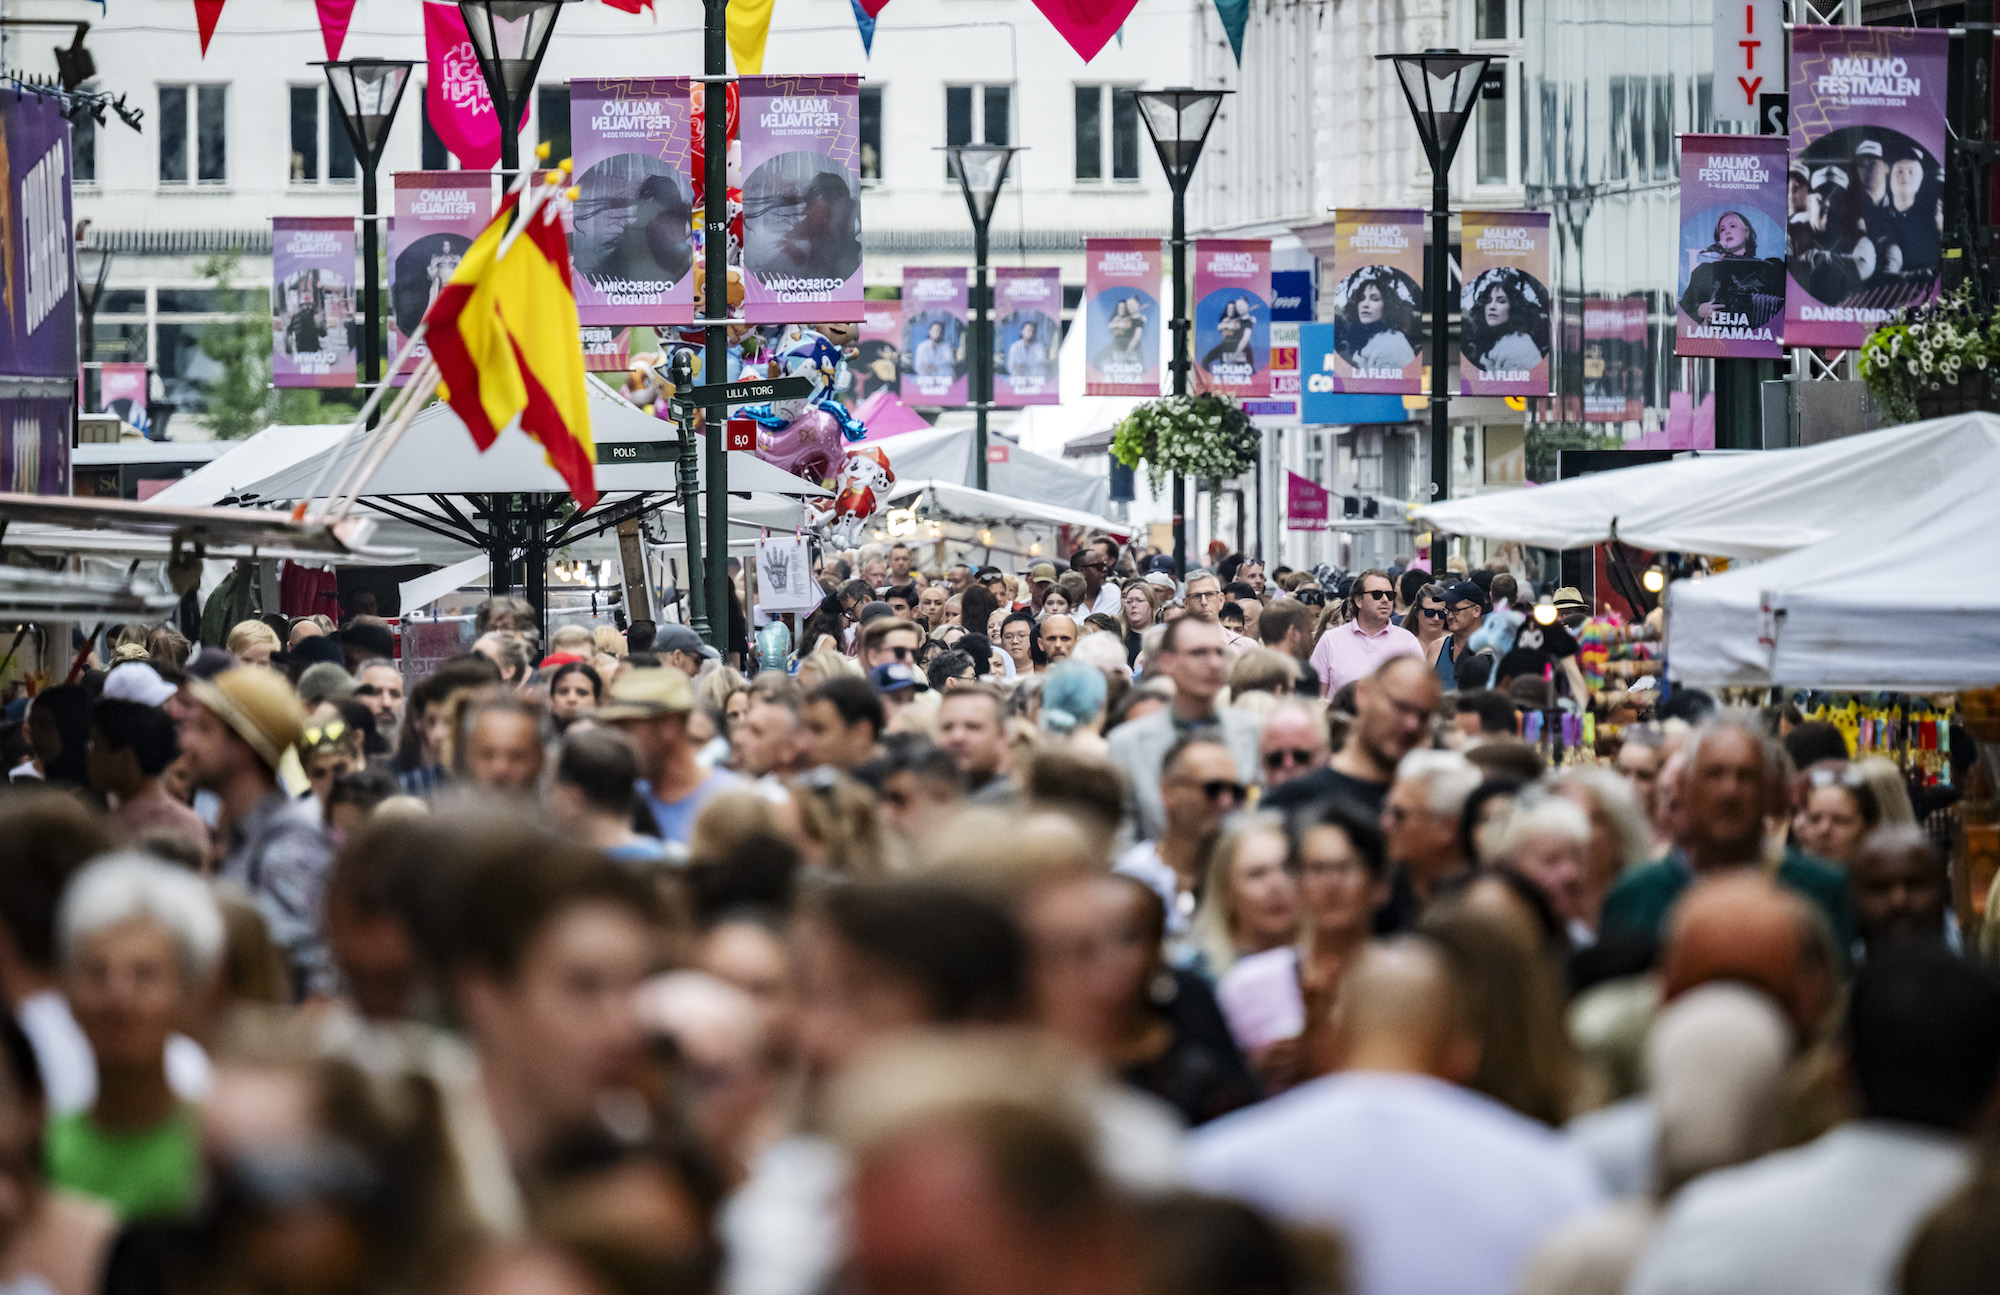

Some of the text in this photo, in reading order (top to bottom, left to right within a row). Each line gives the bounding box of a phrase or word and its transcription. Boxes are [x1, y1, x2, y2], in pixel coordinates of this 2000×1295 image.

[1832, 57, 1908, 78] MALMÖ
[1818, 75, 1920, 96] FESTIVALEN
[1708, 156, 1760, 170] MALMÖ
[1699, 168, 1769, 183] FESTIVALEN
[1358, 225, 1401, 237] MALMÖ
[1484, 227, 1527, 240] MALMÖ
[1350, 236, 1408, 248] FESTIVALEN
[1476, 239, 1535, 250] FESTIVALEN
[1711, 312, 1749, 326] LEIJA
[1686, 325, 1774, 341] LAUTAMAJA
[1352, 368, 1403, 379] LA FLEUR
[1479, 370, 1530, 381] LA FLEUR
[726, 386, 774, 398] LILLA TORG
[734, 435, 748, 447] 8,0
[613, 448, 636, 458] POLIS
